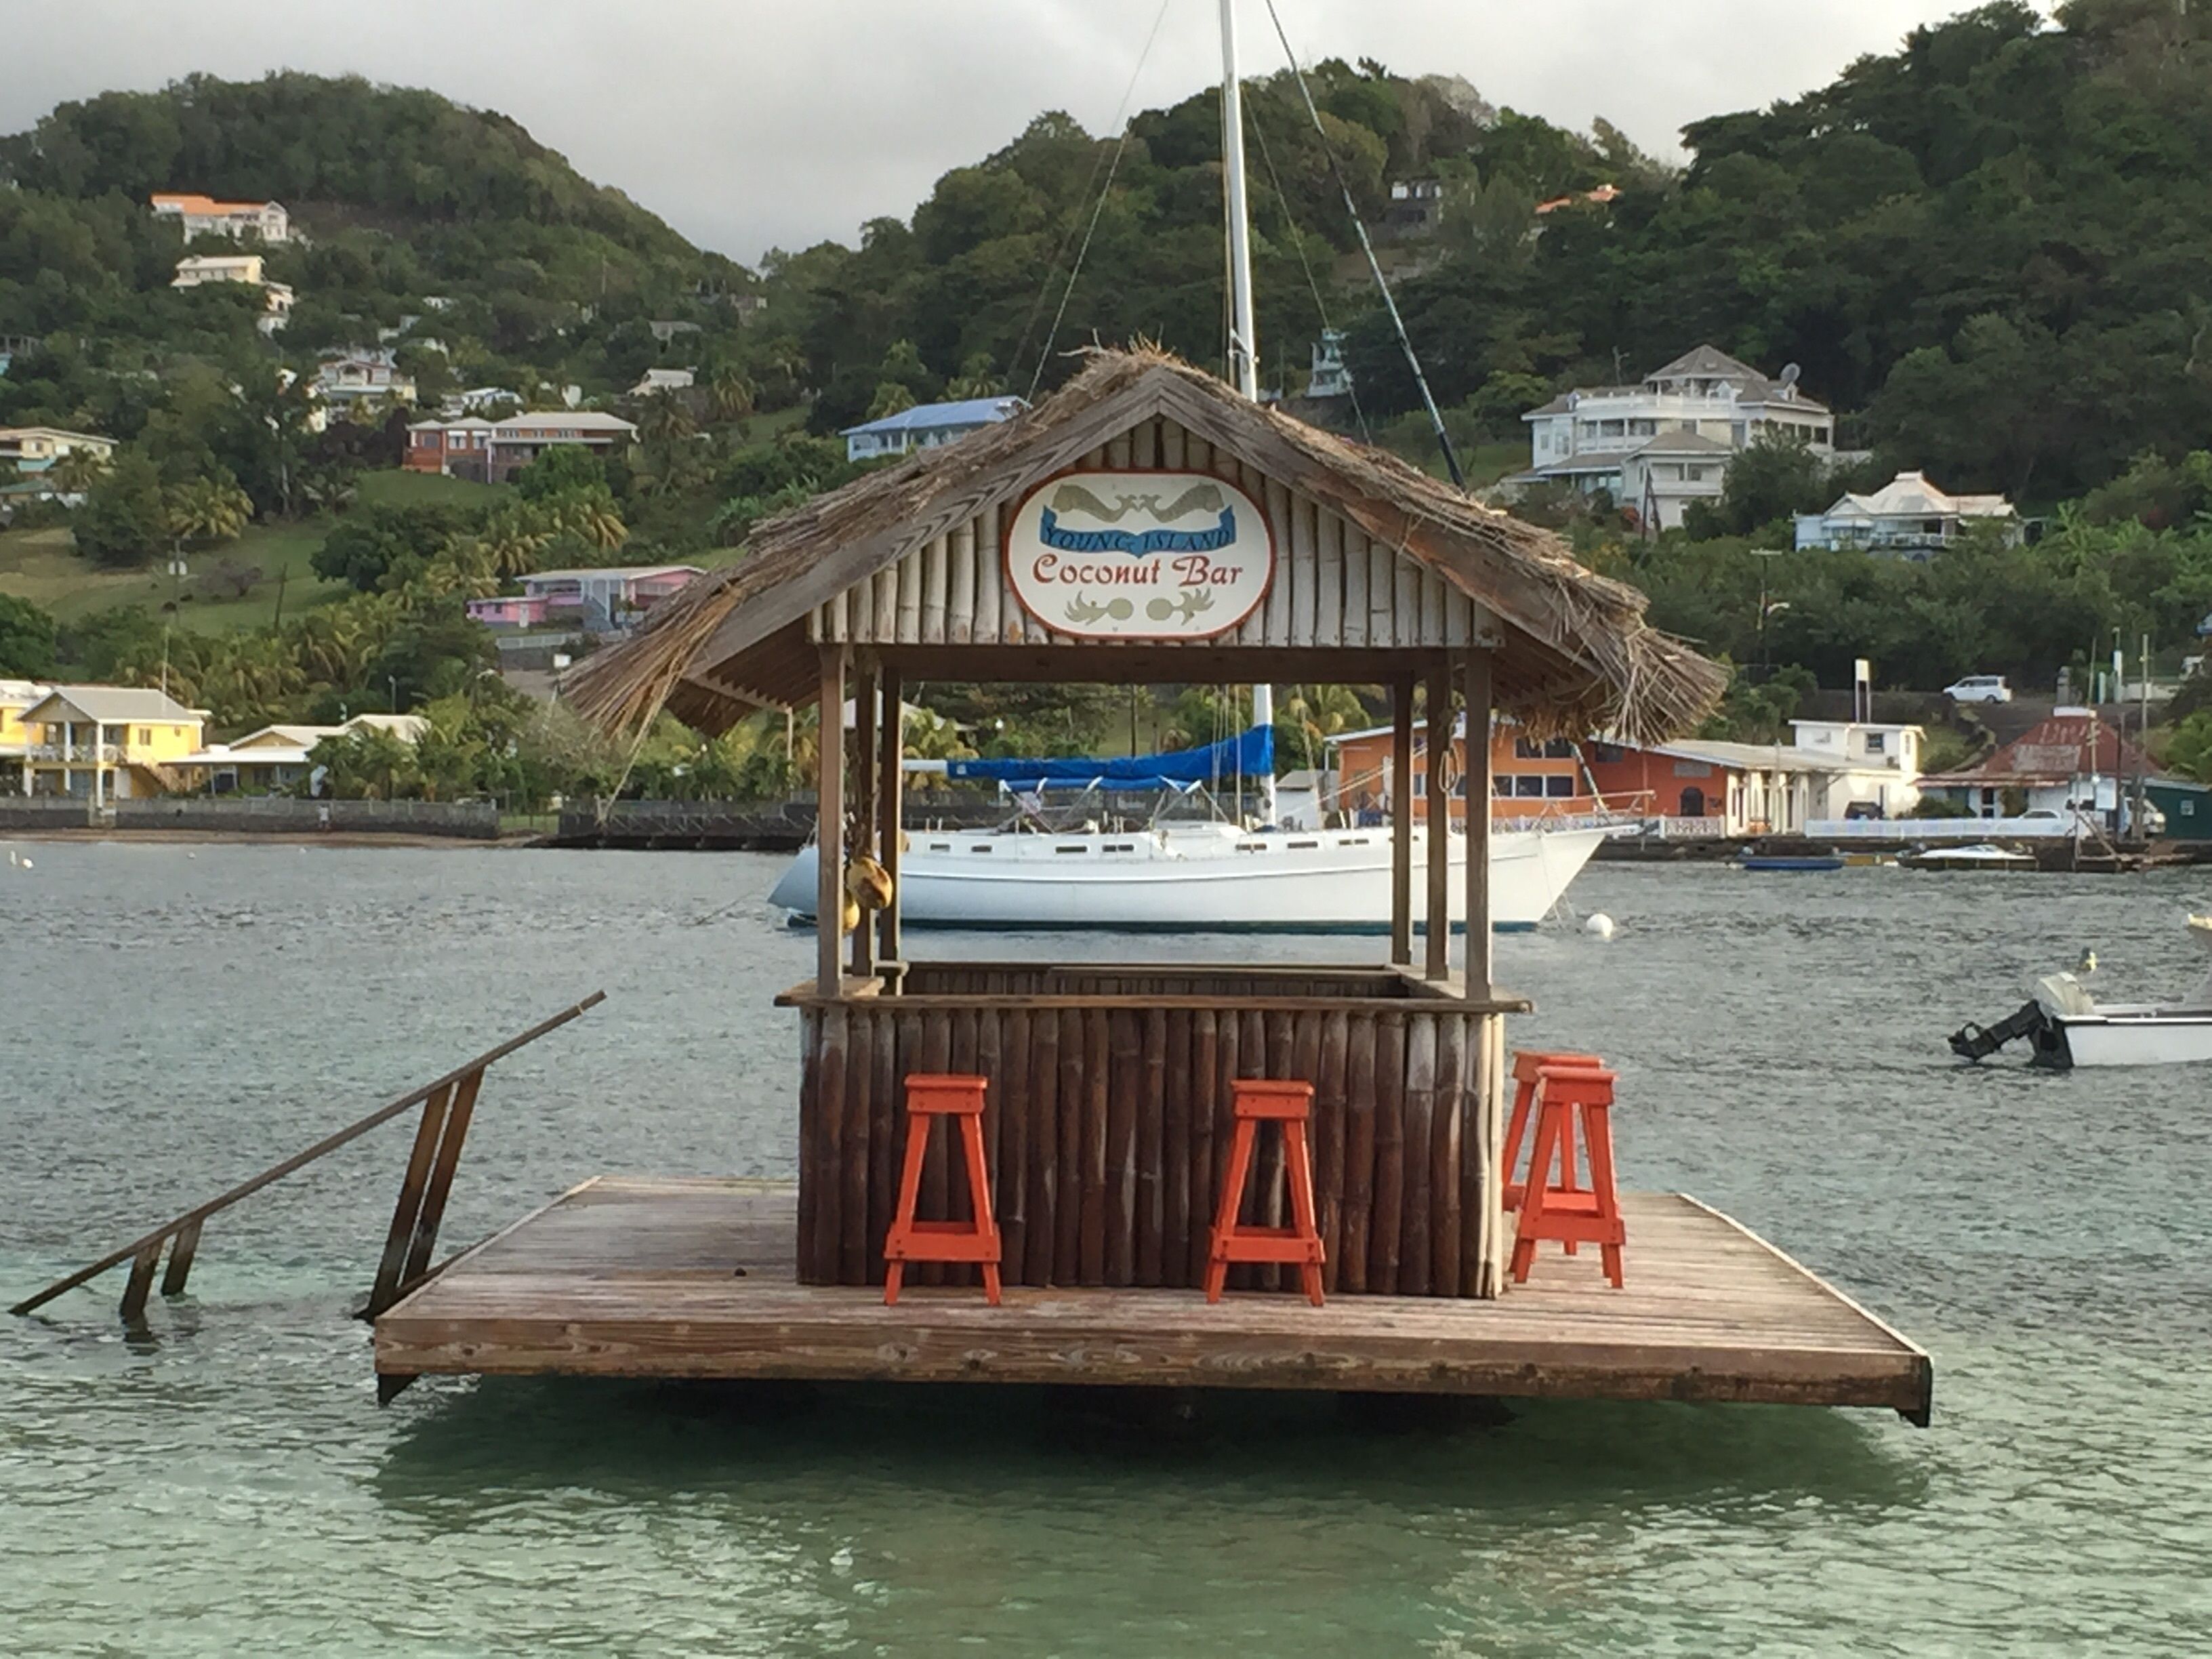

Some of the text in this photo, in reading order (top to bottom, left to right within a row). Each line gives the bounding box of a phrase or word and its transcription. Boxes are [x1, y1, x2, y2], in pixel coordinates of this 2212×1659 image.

[1046, 527, 1230, 551] YOUNG ISLAND
[1033, 553, 1243, 587] Coconut Bar
